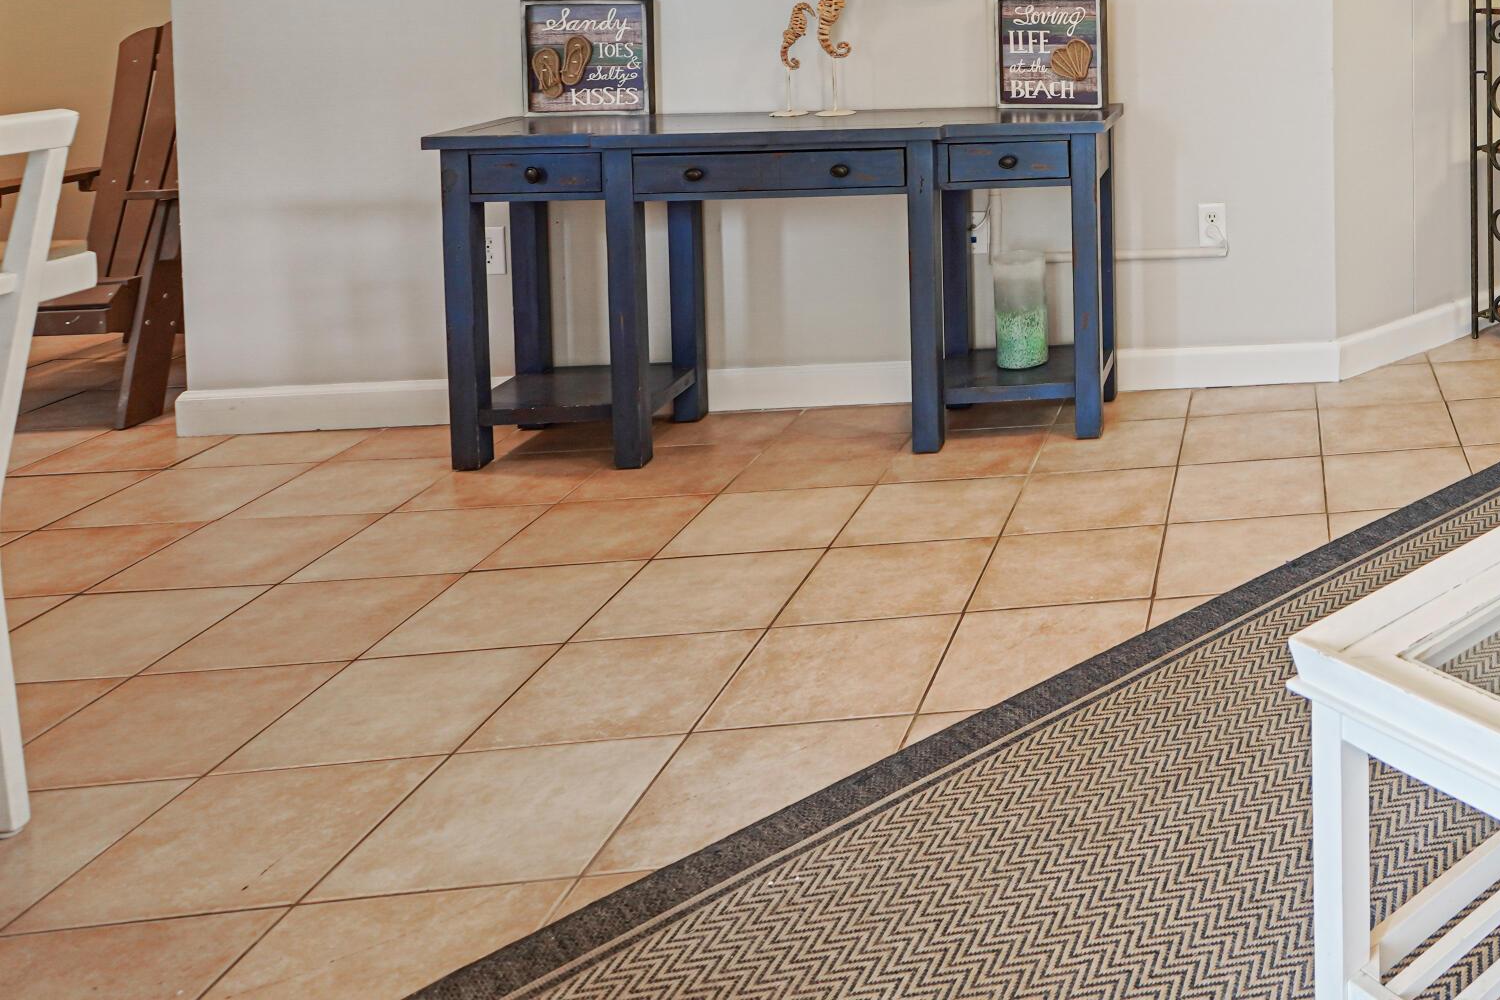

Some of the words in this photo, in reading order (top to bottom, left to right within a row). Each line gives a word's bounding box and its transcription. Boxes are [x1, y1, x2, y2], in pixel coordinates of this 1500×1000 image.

[542, 7, 632, 41] Sandy
[1013, 4, 1086, 37] Loving
[593, 42, 634, 59] TOES
[1008, 30, 1051, 54] LIFE
[627, 56, 641, 70] &
[1009, 58, 1026, 73] at
[1026, 57, 1049, 73] the
[586, 66, 638, 87] Salty
[571, 87, 640, 106] KISSES
[1010, 80, 1075, 99] BEACH
